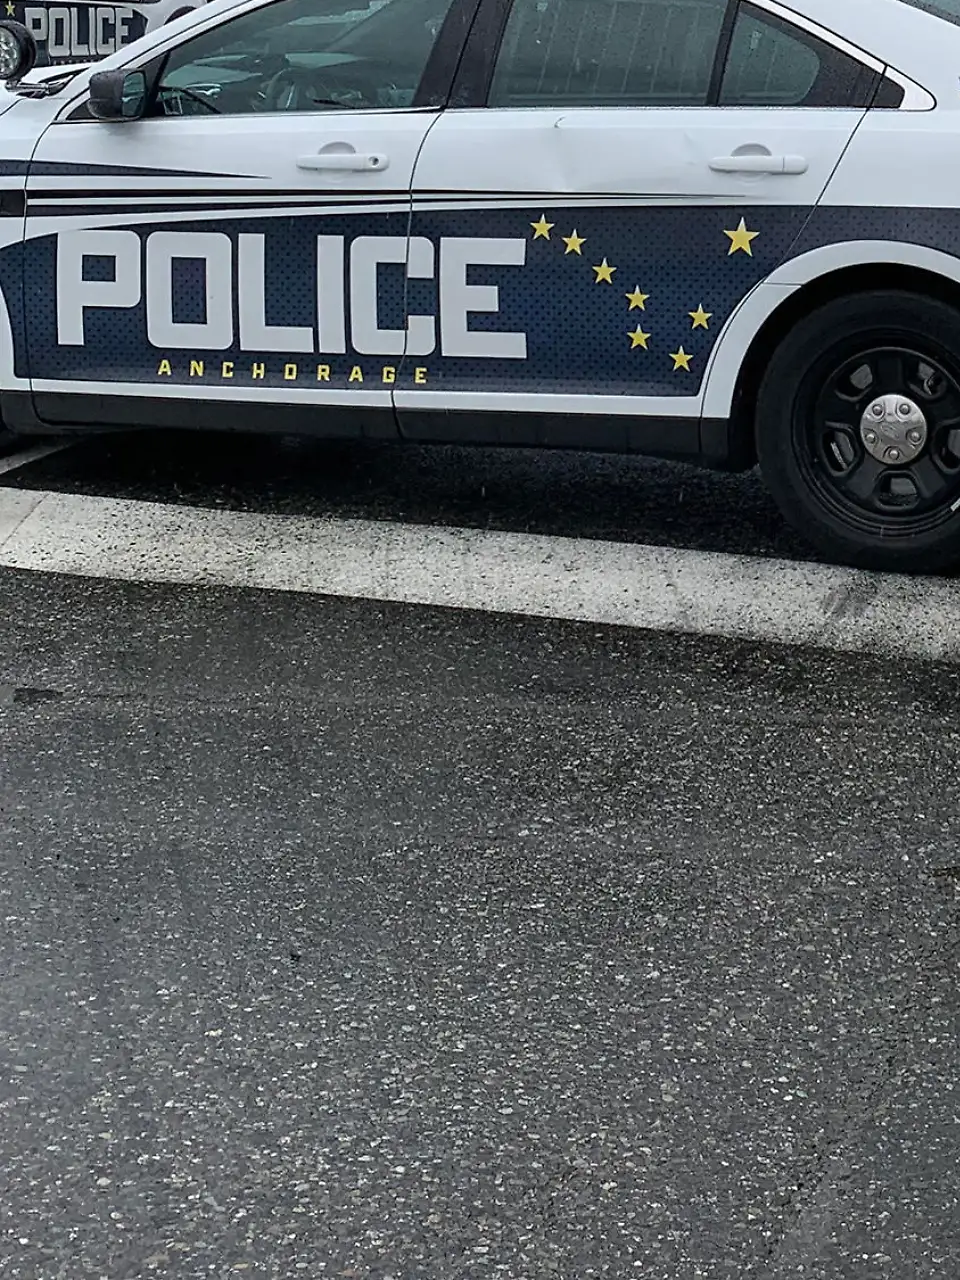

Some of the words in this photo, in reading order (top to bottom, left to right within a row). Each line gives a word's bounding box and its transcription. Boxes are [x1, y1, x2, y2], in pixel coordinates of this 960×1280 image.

[24, 7, 134, 57] POLICE
[57, 230, 527, 359] POLICE
[158, 359, 429, 384] ANCHORAGE
